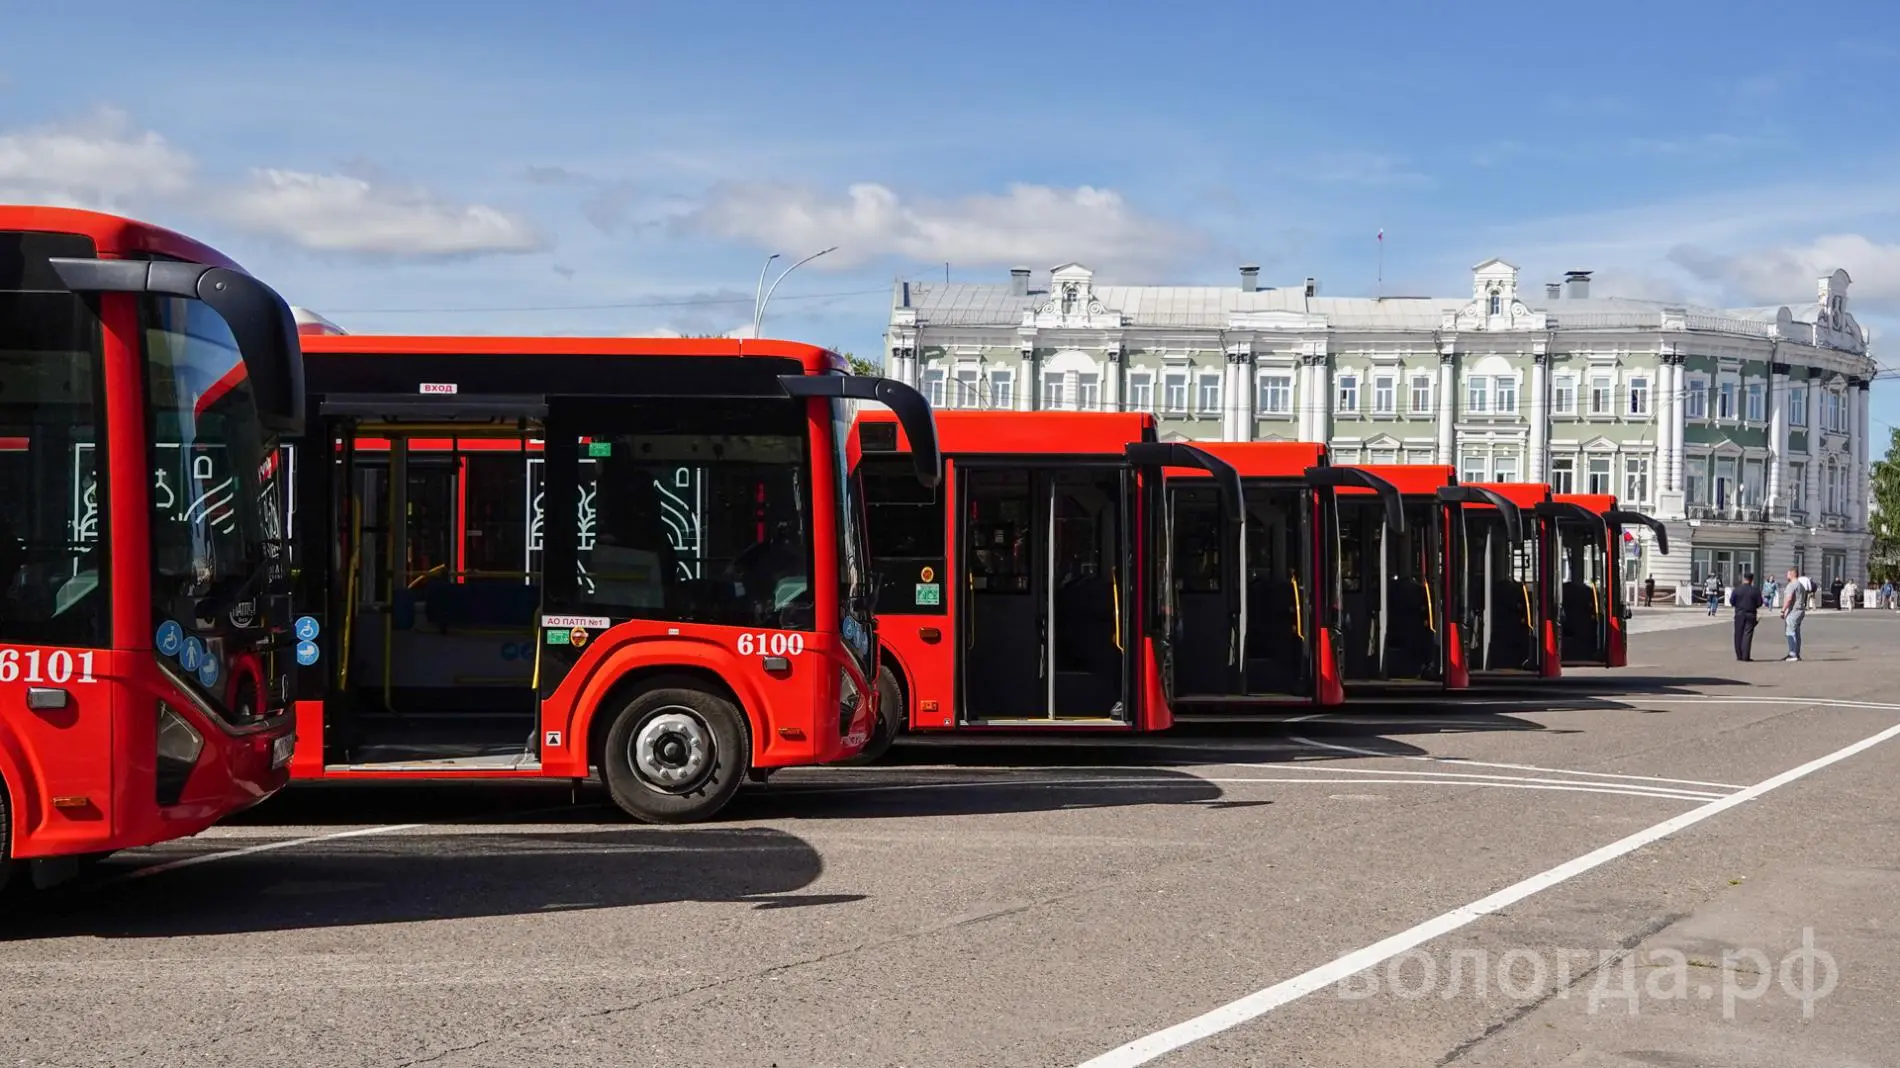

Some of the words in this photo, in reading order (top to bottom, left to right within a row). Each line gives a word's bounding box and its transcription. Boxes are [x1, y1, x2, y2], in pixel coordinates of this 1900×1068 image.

[424, 384, 452, 392] ВХОД
[547, 617, 560, 625] АО
[562, 618, 586, 626] ПАТП
[737, 632, 804, 656] 6100
[0, 648, 97, 683] 6101
